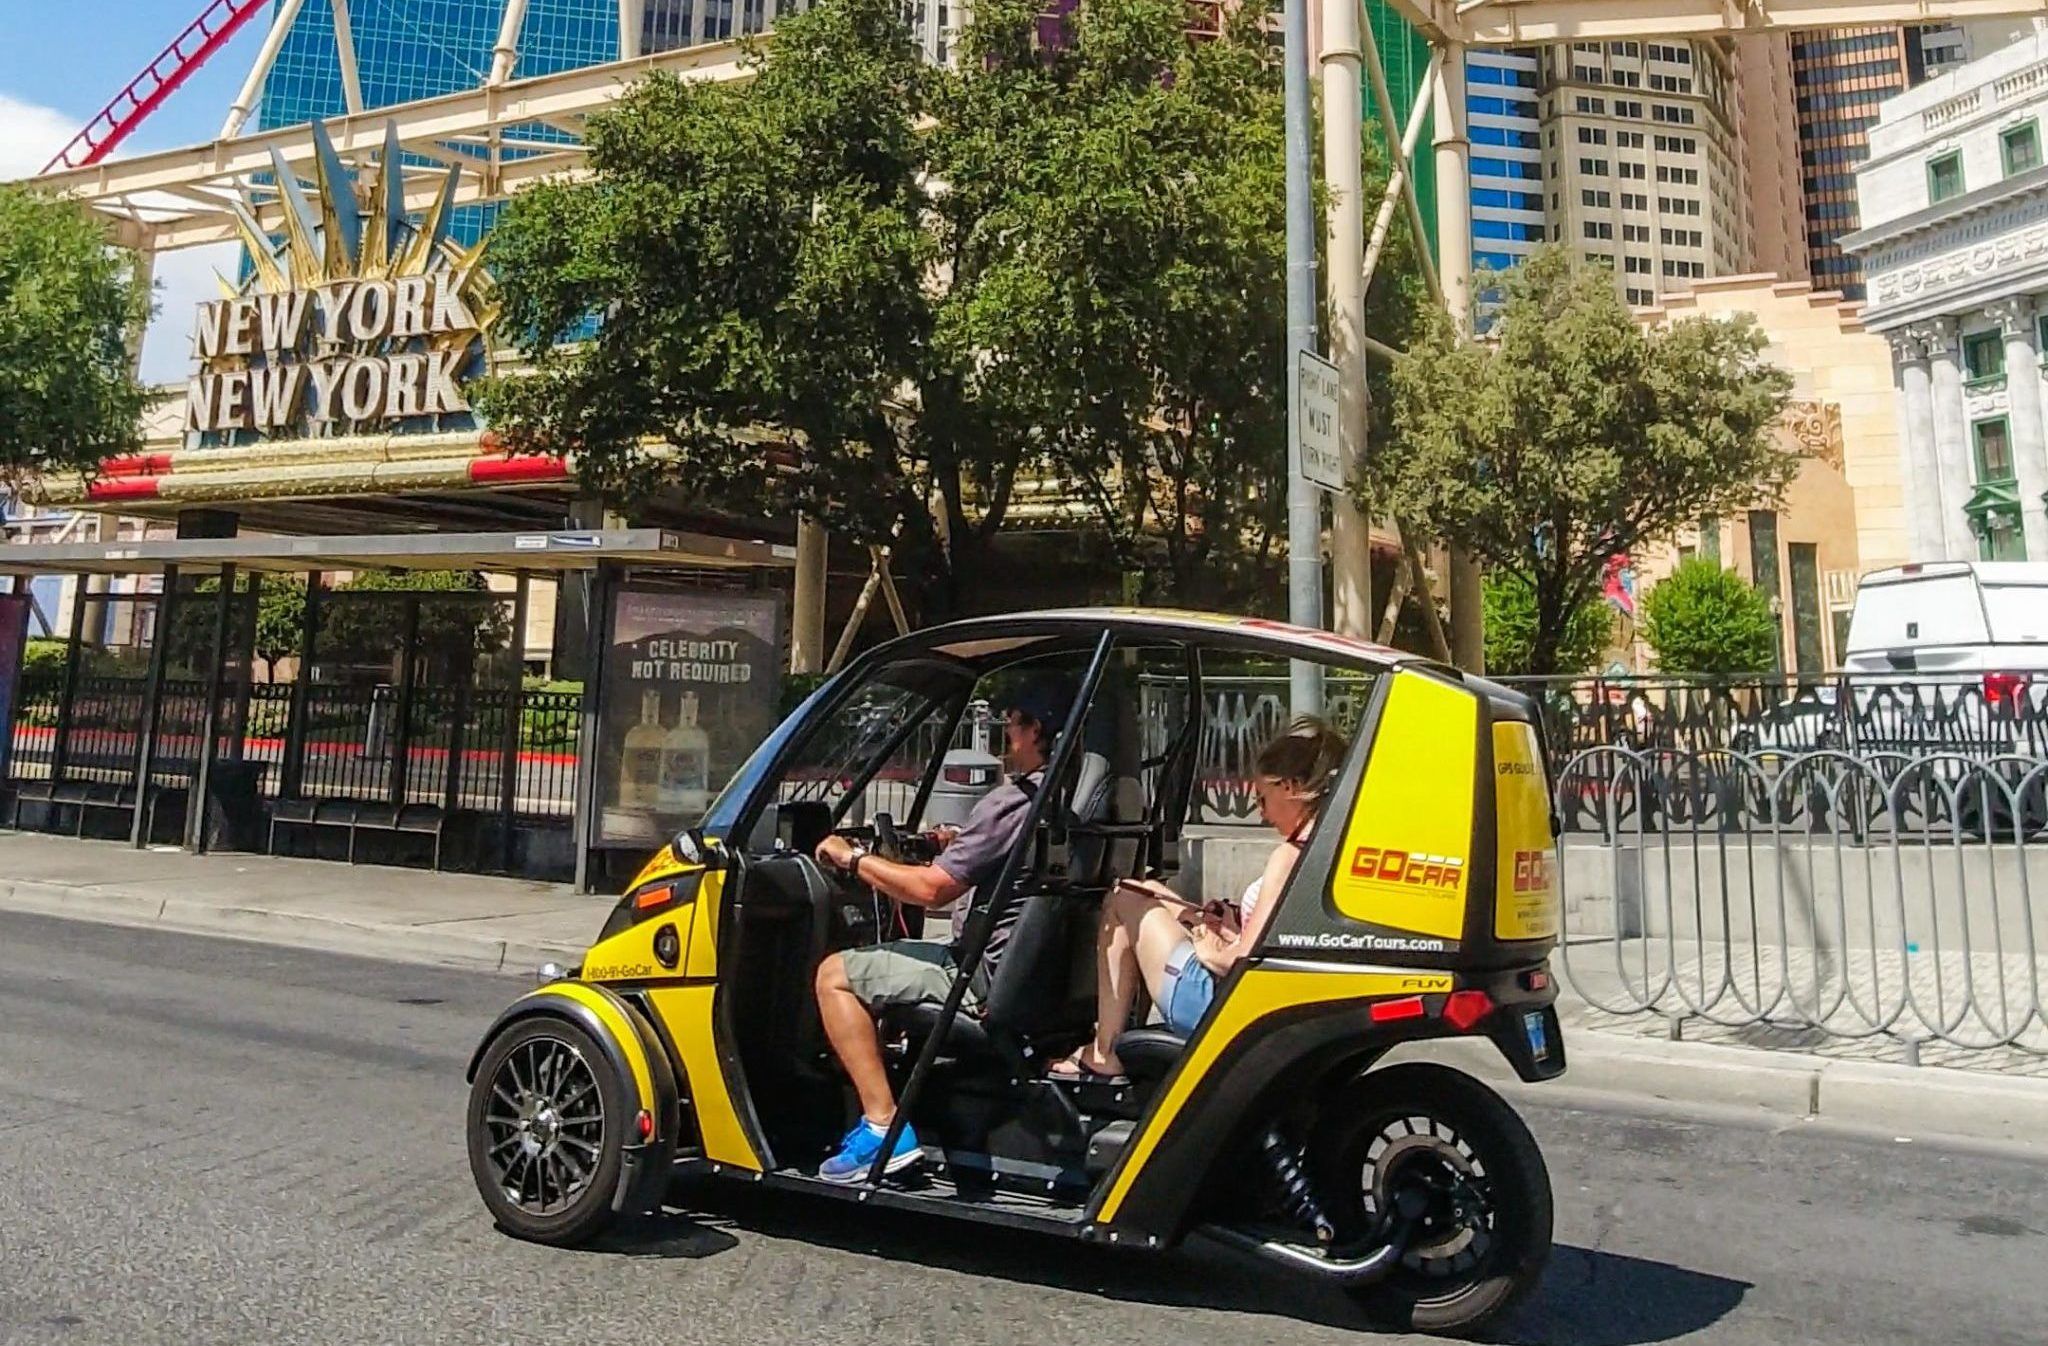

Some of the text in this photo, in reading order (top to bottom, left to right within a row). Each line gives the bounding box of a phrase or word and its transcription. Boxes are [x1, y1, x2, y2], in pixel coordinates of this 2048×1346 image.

[191, 269, 480, 358] NEW YORK
[184, 350, 472, 432] NEW YORK
[1308, 406, 1331, 437] MUST
[649, 639, 740, 661] CELEBRITY
[631, 659, 752, 684] NOT REQUIRED
[1278, 933, 1443, 952] www.GoCarTours.com
[1401, 979, 1449, 989] FUV
